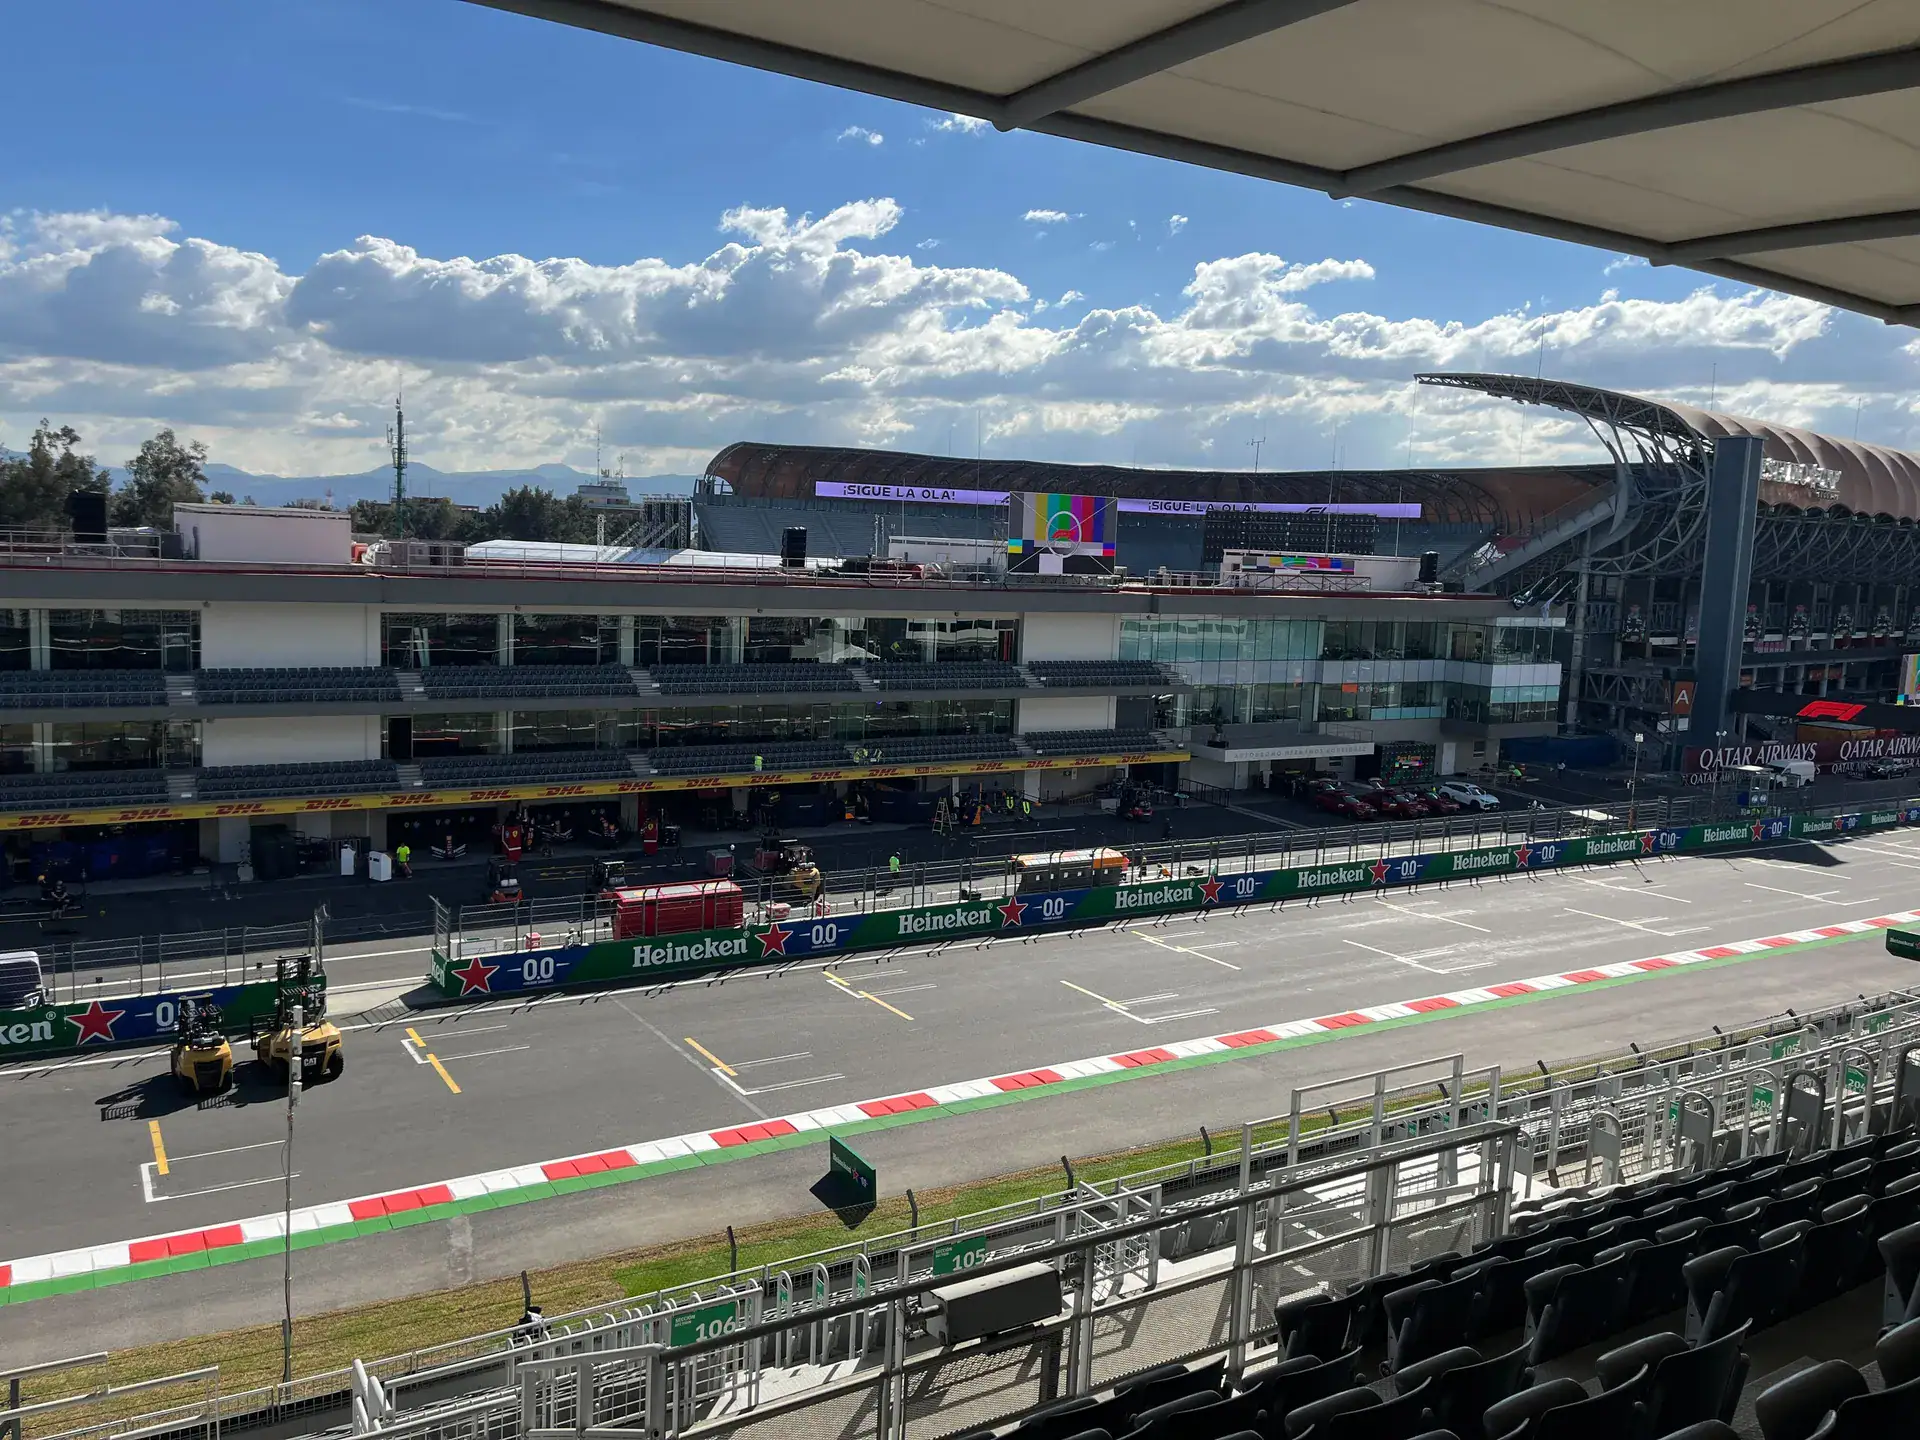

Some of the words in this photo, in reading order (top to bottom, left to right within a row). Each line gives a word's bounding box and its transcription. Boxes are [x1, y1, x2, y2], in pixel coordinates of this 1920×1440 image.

[843, 485, 891, 496] ¡SIGUE
[897, 487, 915, 499] LA
[922, 489, 955, 500] OLA!
[1148, 501, 1191, 511] ¡SIGUE
[1196, 502, 1215, 512] LA
[1675, 689, 1689, 704] A
[1700, 748, 1753, 770] QATAR
[1756, 742, 1818, 764] AIRWAYS
[1840, 739, 1885, 760] QATAR
[1026, 760, 1054, 768] DHL
[1075, 757, 1101, 766] DHL
[1122, 755, 1147, 763] DHL
[868, 768, 901, 777] DHL
[976, 762, 1004, 771] DHL
[750, 775, 784, 785] DHL
[810, 771, 842, 781] DHL
[618, 781, 656, 792] DHL
[687, 778, 722, 788] DHL
[469, 790, 512, 801] DHL
[546, 784, 587, 797] DHL
[305, 798, 354, 810] DHL
[389, 793, 435, 805] DHL
[119, 808, 173, 821] DHL
[215, 803, 266, 815] DHL
[19, 813, 75, 827] DHL
[1703, 828, 1748, 843] Heineken
[1586, 837, 1637, 855] Heineken
[1453, 852, 1510, 871] Heineken
[1297, 867, 1364, 888] Heineken
[1401, 860, 1417, 876] 0.0
[1114, 886, 1194, 909] Heineken
[1236, 877, 1255, 895] 0.0
[898, 908, 992, 934] Heineken
[1043, 897, 1064, 918] 0.0
[632, 935, 748, 968] Heineken
[811, 923, 837, 945] 0.0
[523, 957, 555, 981] 0.0
[303, 1057, 317, 1067] CAT
[952, 1248, 986, 1271] 105
[695, 1315, 736, 1344] 106
